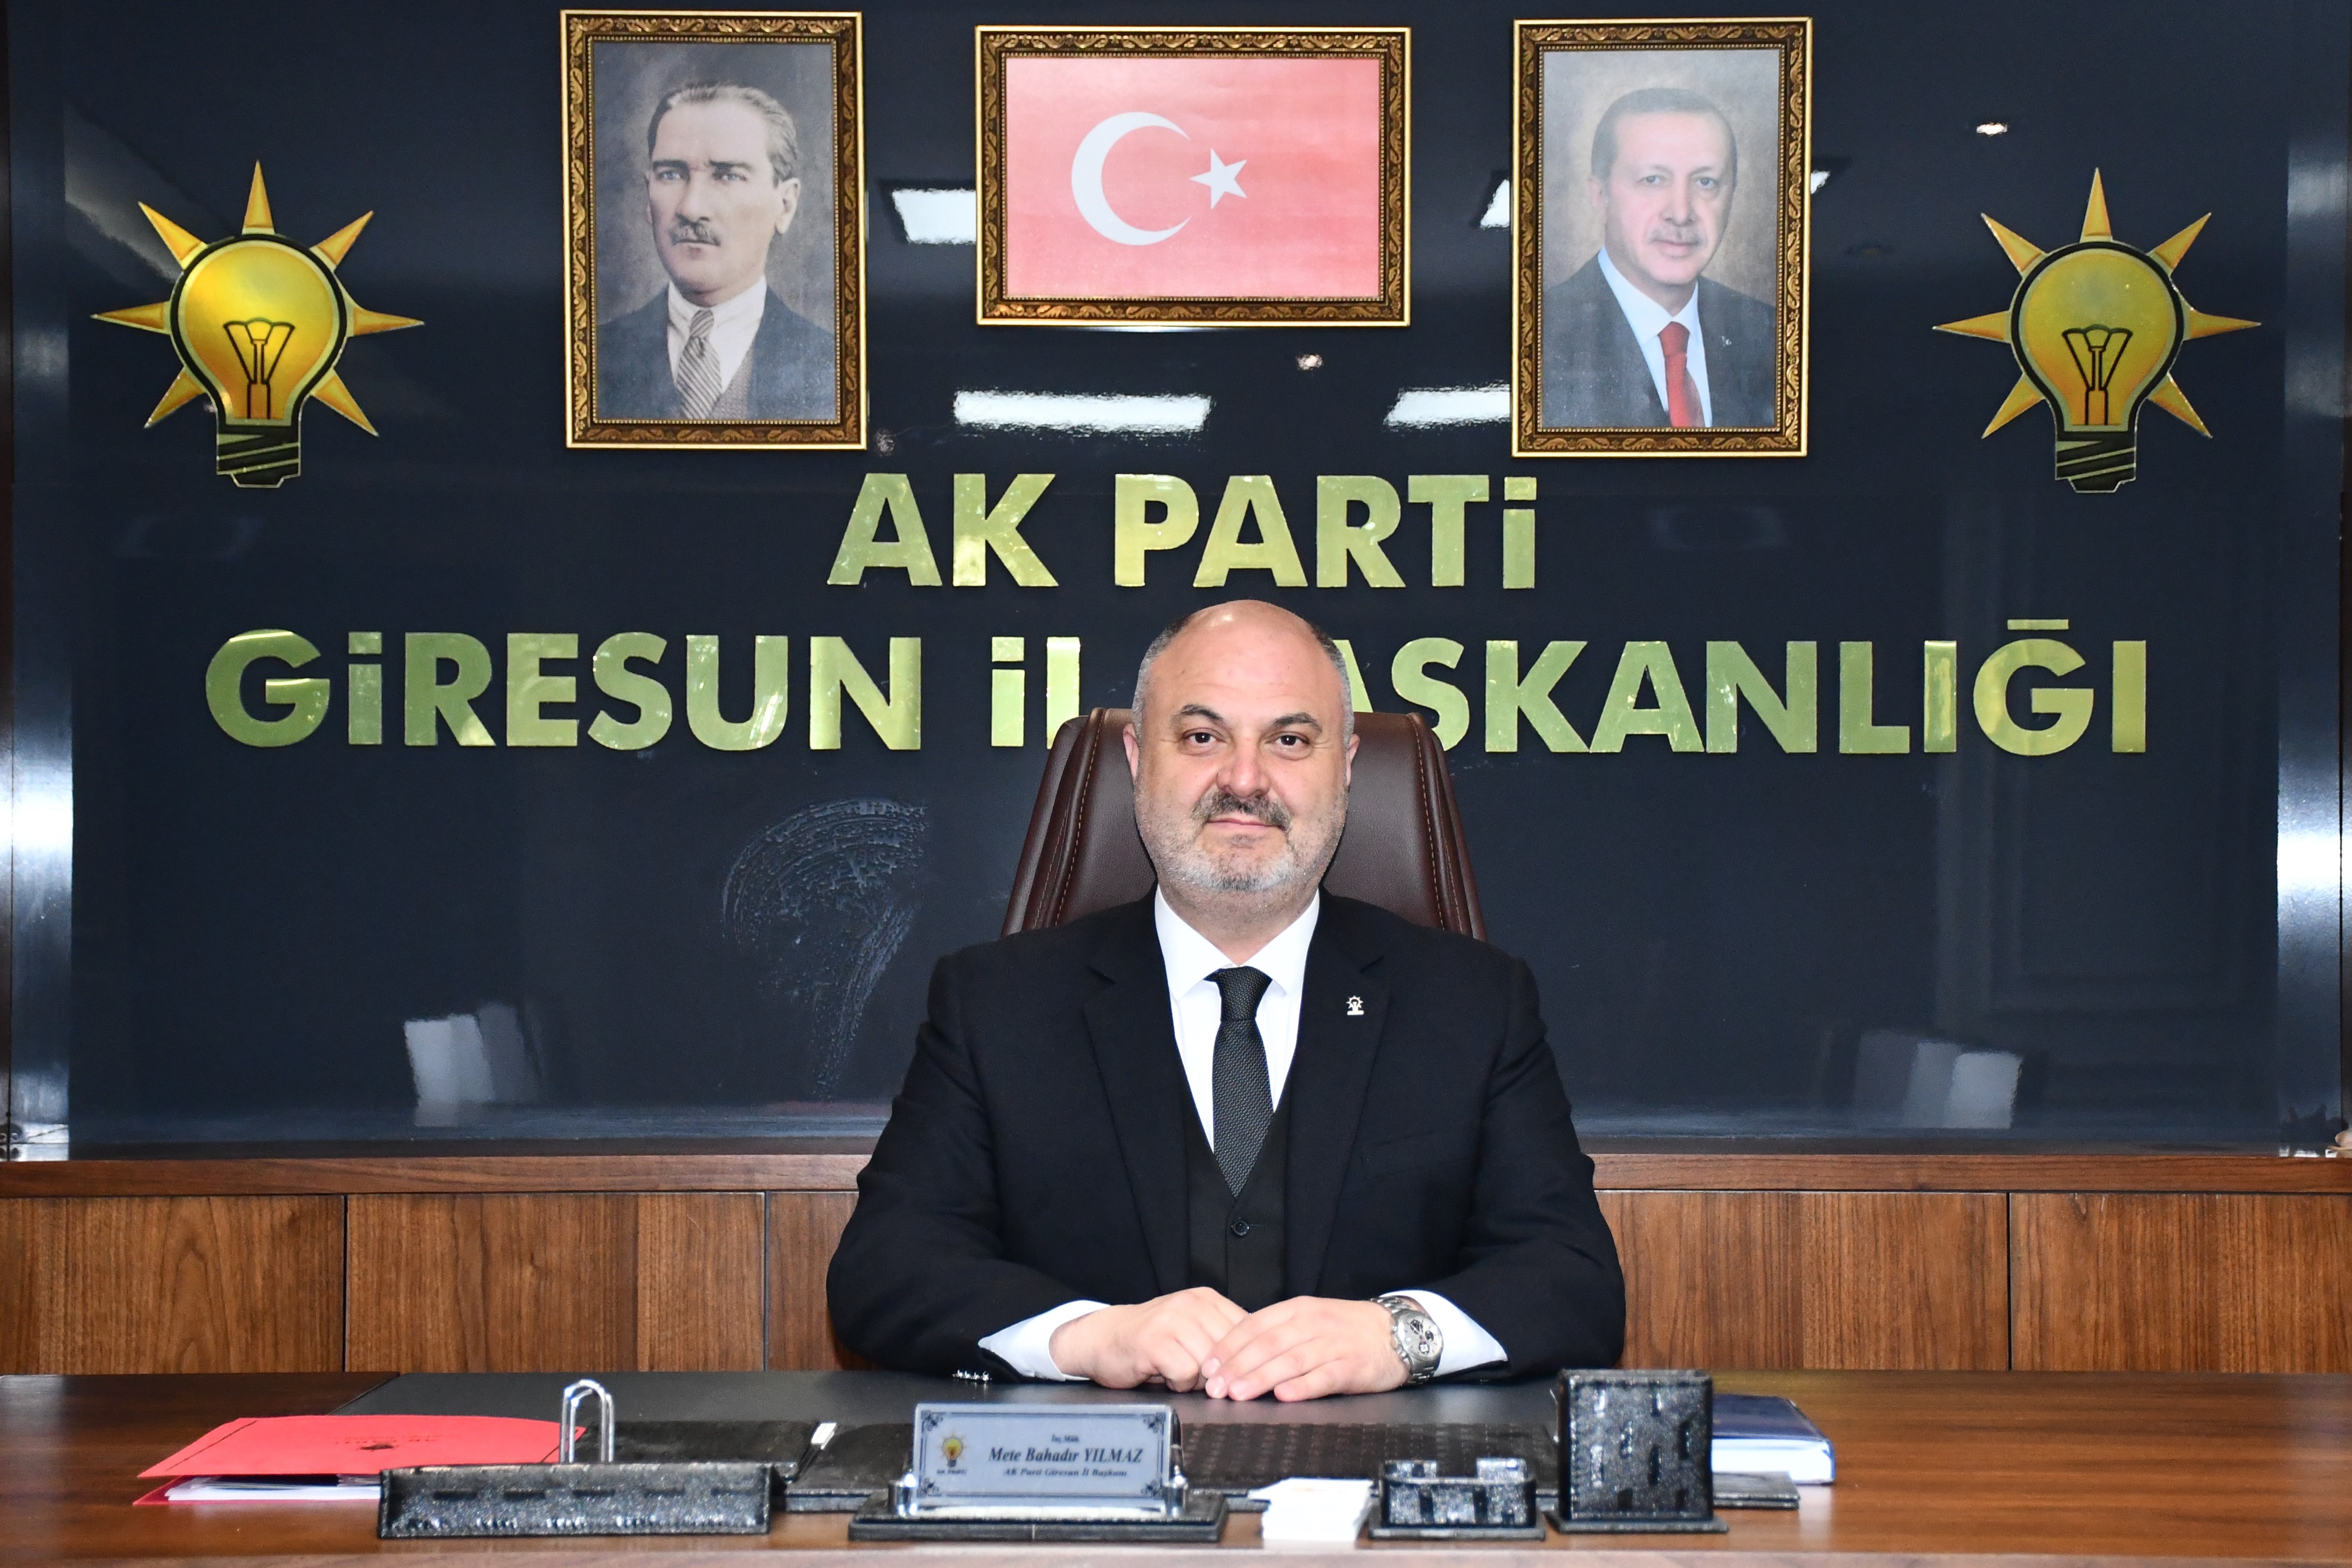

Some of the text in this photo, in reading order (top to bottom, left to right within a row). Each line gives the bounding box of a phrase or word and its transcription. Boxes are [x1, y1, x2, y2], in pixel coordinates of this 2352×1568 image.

[826, 473, 1538, 589] AK PARTİ
[205, 628, 922, 752] GİRESUN
[989, 1447, 1144, 1463] Mete Bahadır YILMAZ
